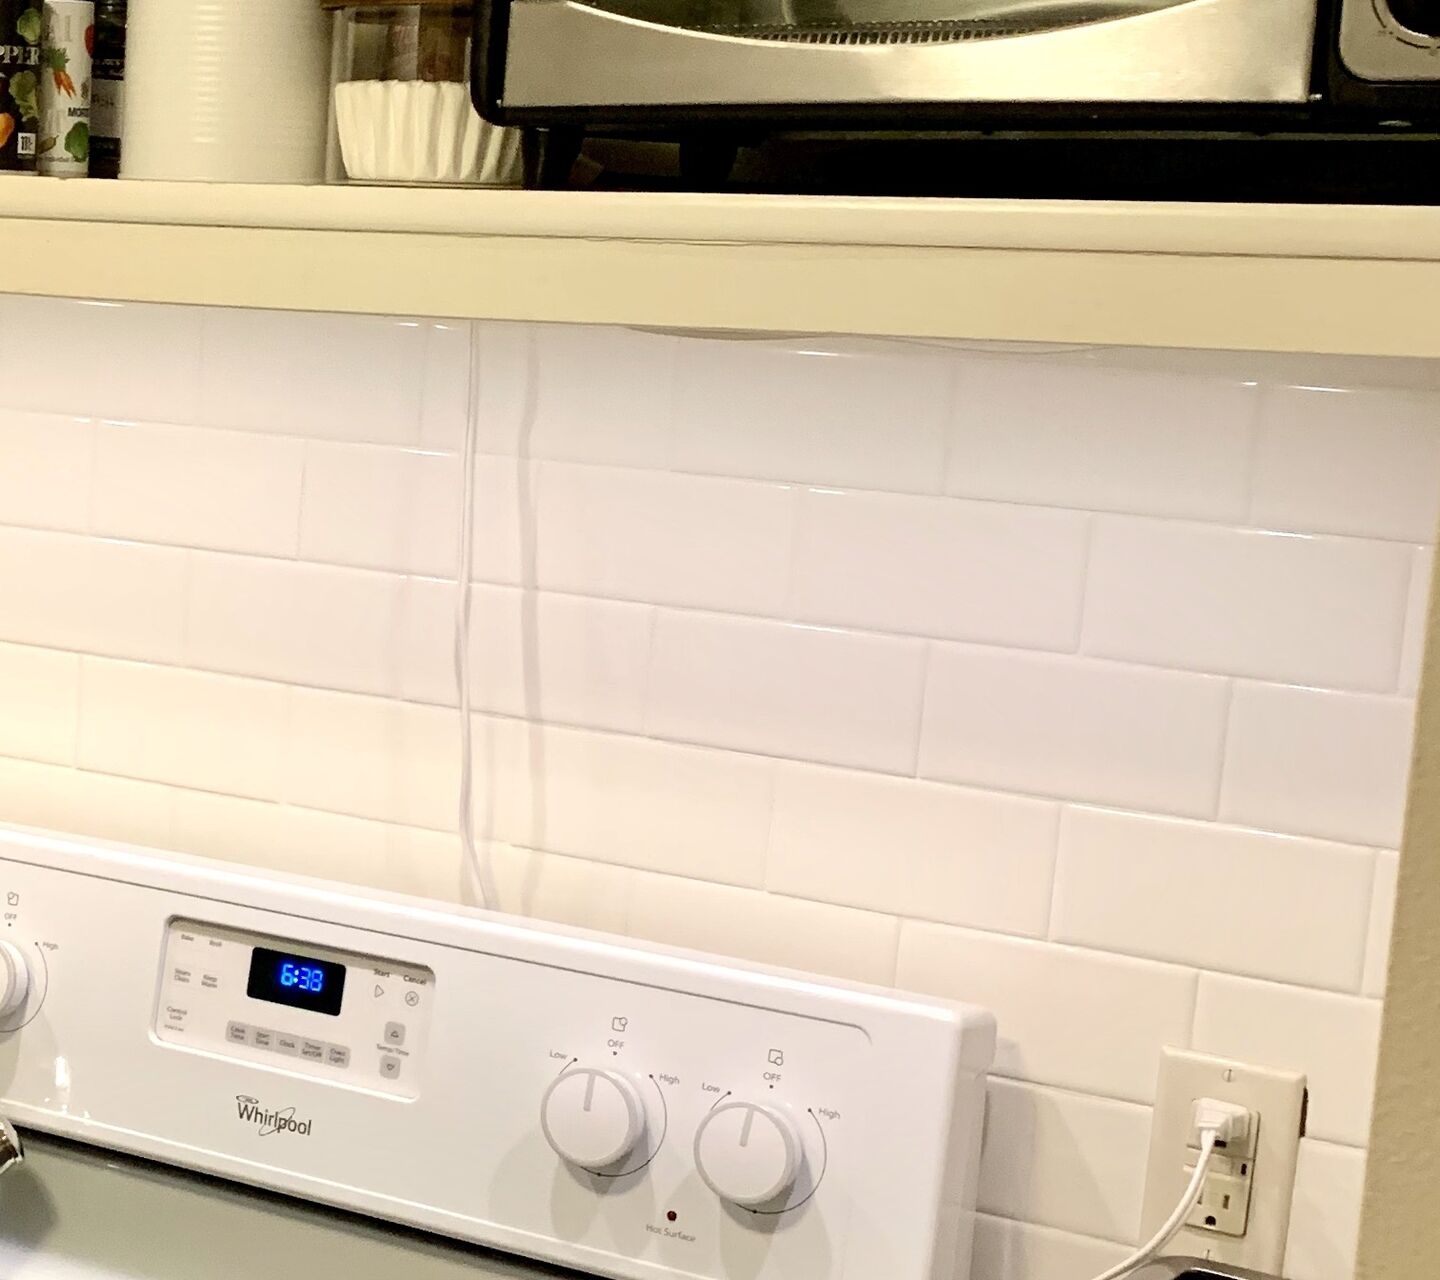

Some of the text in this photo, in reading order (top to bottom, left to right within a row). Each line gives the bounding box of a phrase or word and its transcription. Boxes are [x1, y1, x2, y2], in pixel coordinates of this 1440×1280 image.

[4, 912, 18, 920] OFF
[42, 940, 59, 951] High
[281, 964, 324, 992] 6:38
[374, 968, 390, 978] Start
[402, 974, 427, 986] Cancel
[607, 1038, 624, 1050] OFF
[550, 1048, 568, 1060] Low
[660, 1073, 680, 1086] High
[763, 1072, 782, 1083] OFF
[702, 1082, 720, 1094] Low
[238, 1102, 312, 1136] Whirlpool
[818, 1107, 841, 1120] High
[646, 1224, 696, 1243] Hot Surface
